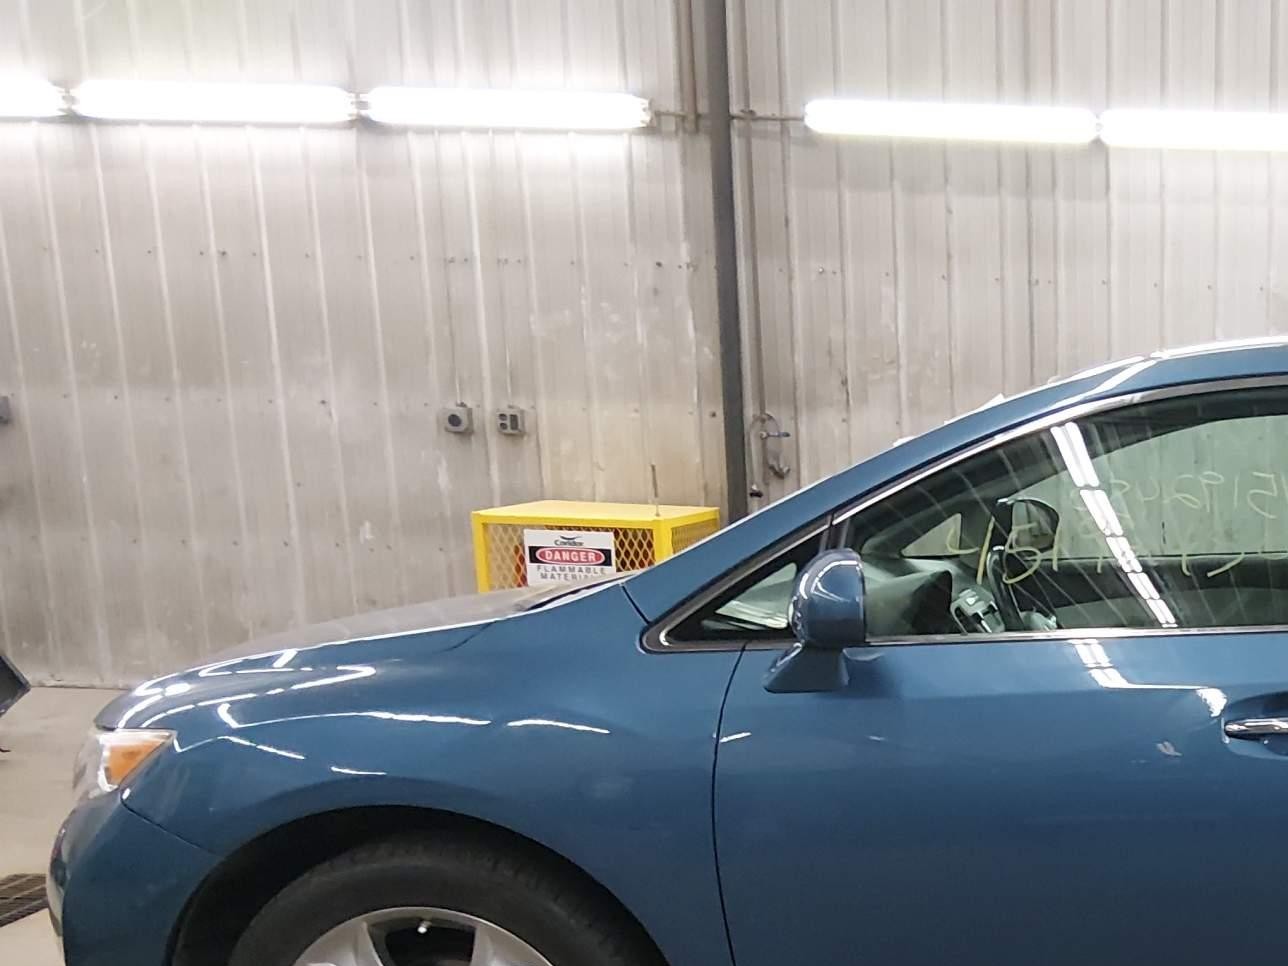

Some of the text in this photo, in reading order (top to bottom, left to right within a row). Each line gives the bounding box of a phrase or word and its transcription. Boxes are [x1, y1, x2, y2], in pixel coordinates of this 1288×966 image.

[544, 550, 596, 563] DANGER
[536, 565, 606, 576] FLAMMABLE
[540, 572, 596, 581] MATERIA
